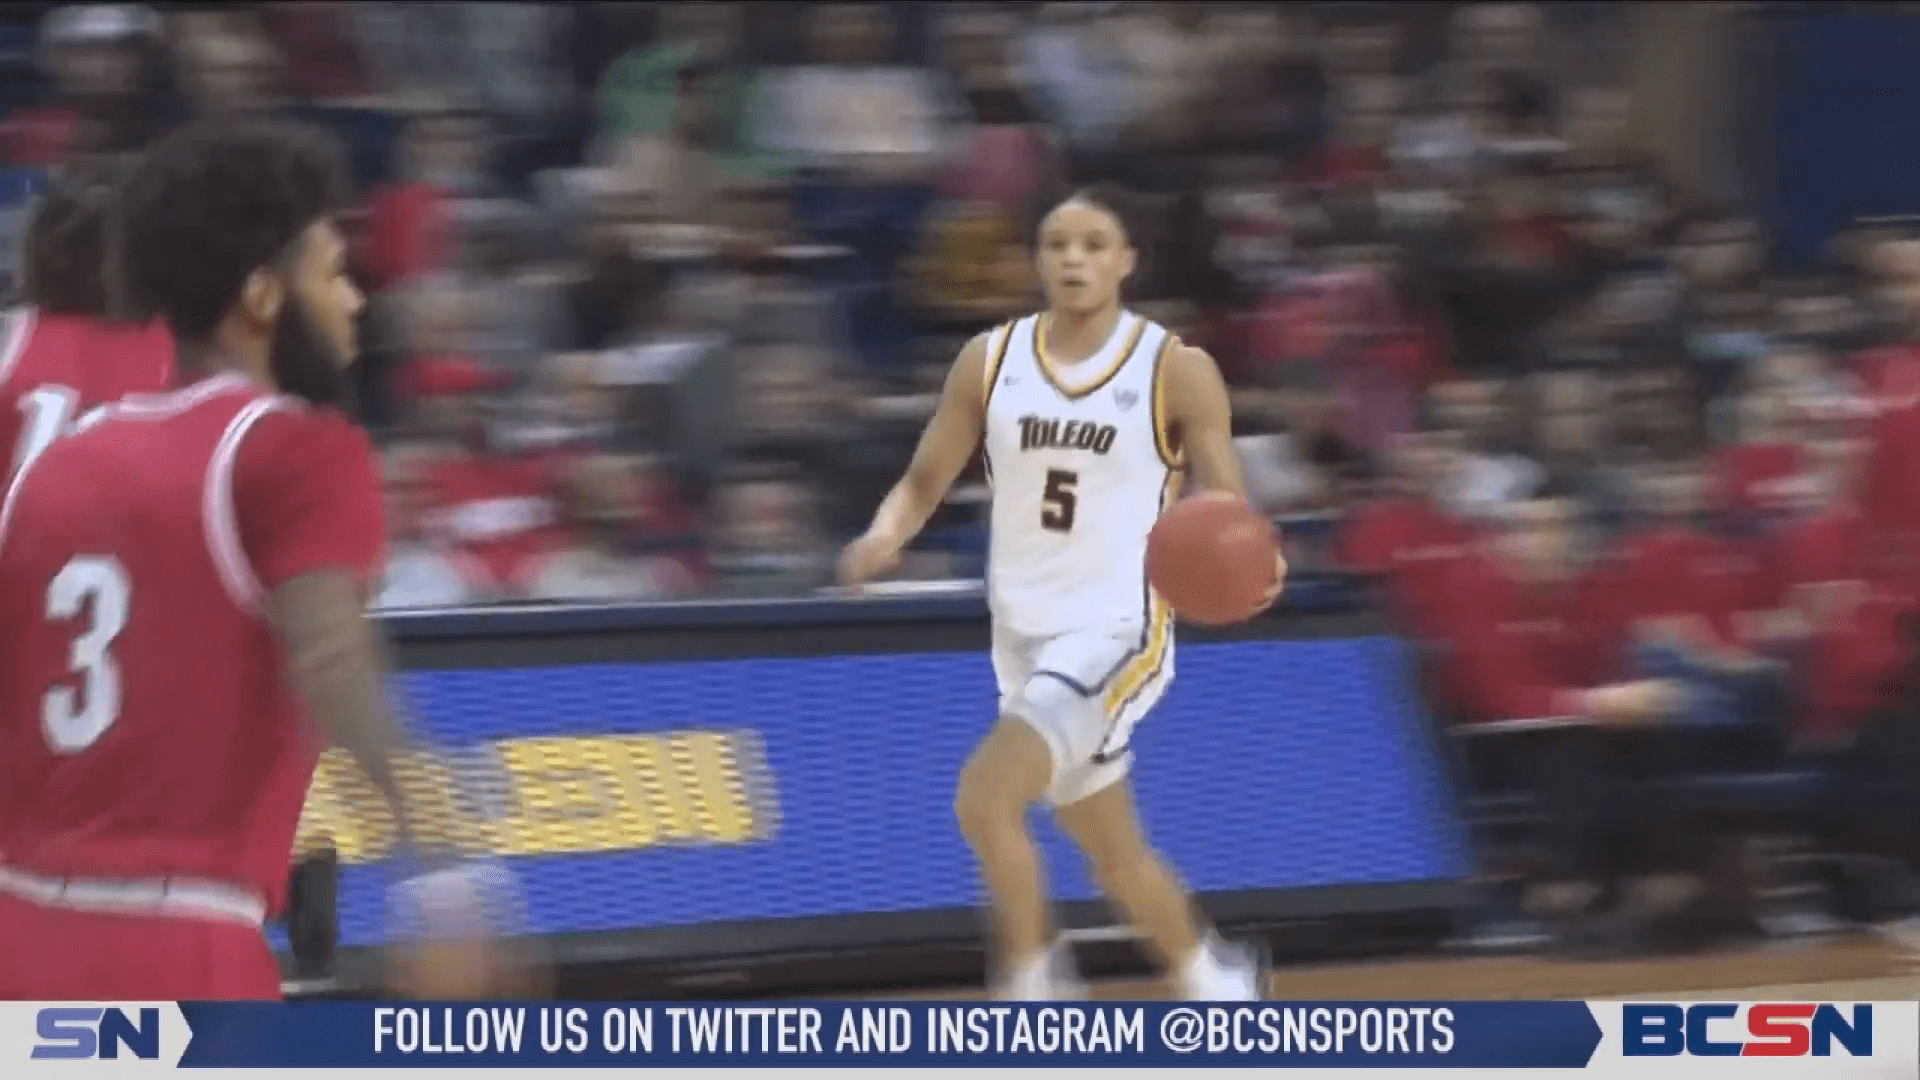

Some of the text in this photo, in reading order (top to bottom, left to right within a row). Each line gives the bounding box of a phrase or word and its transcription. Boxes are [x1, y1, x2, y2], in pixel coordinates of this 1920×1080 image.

[1018, 415, 1118, 455] TOLEDO
[1041, 469, 1078, 532] 5
[41, 553, 132, 754] 3
